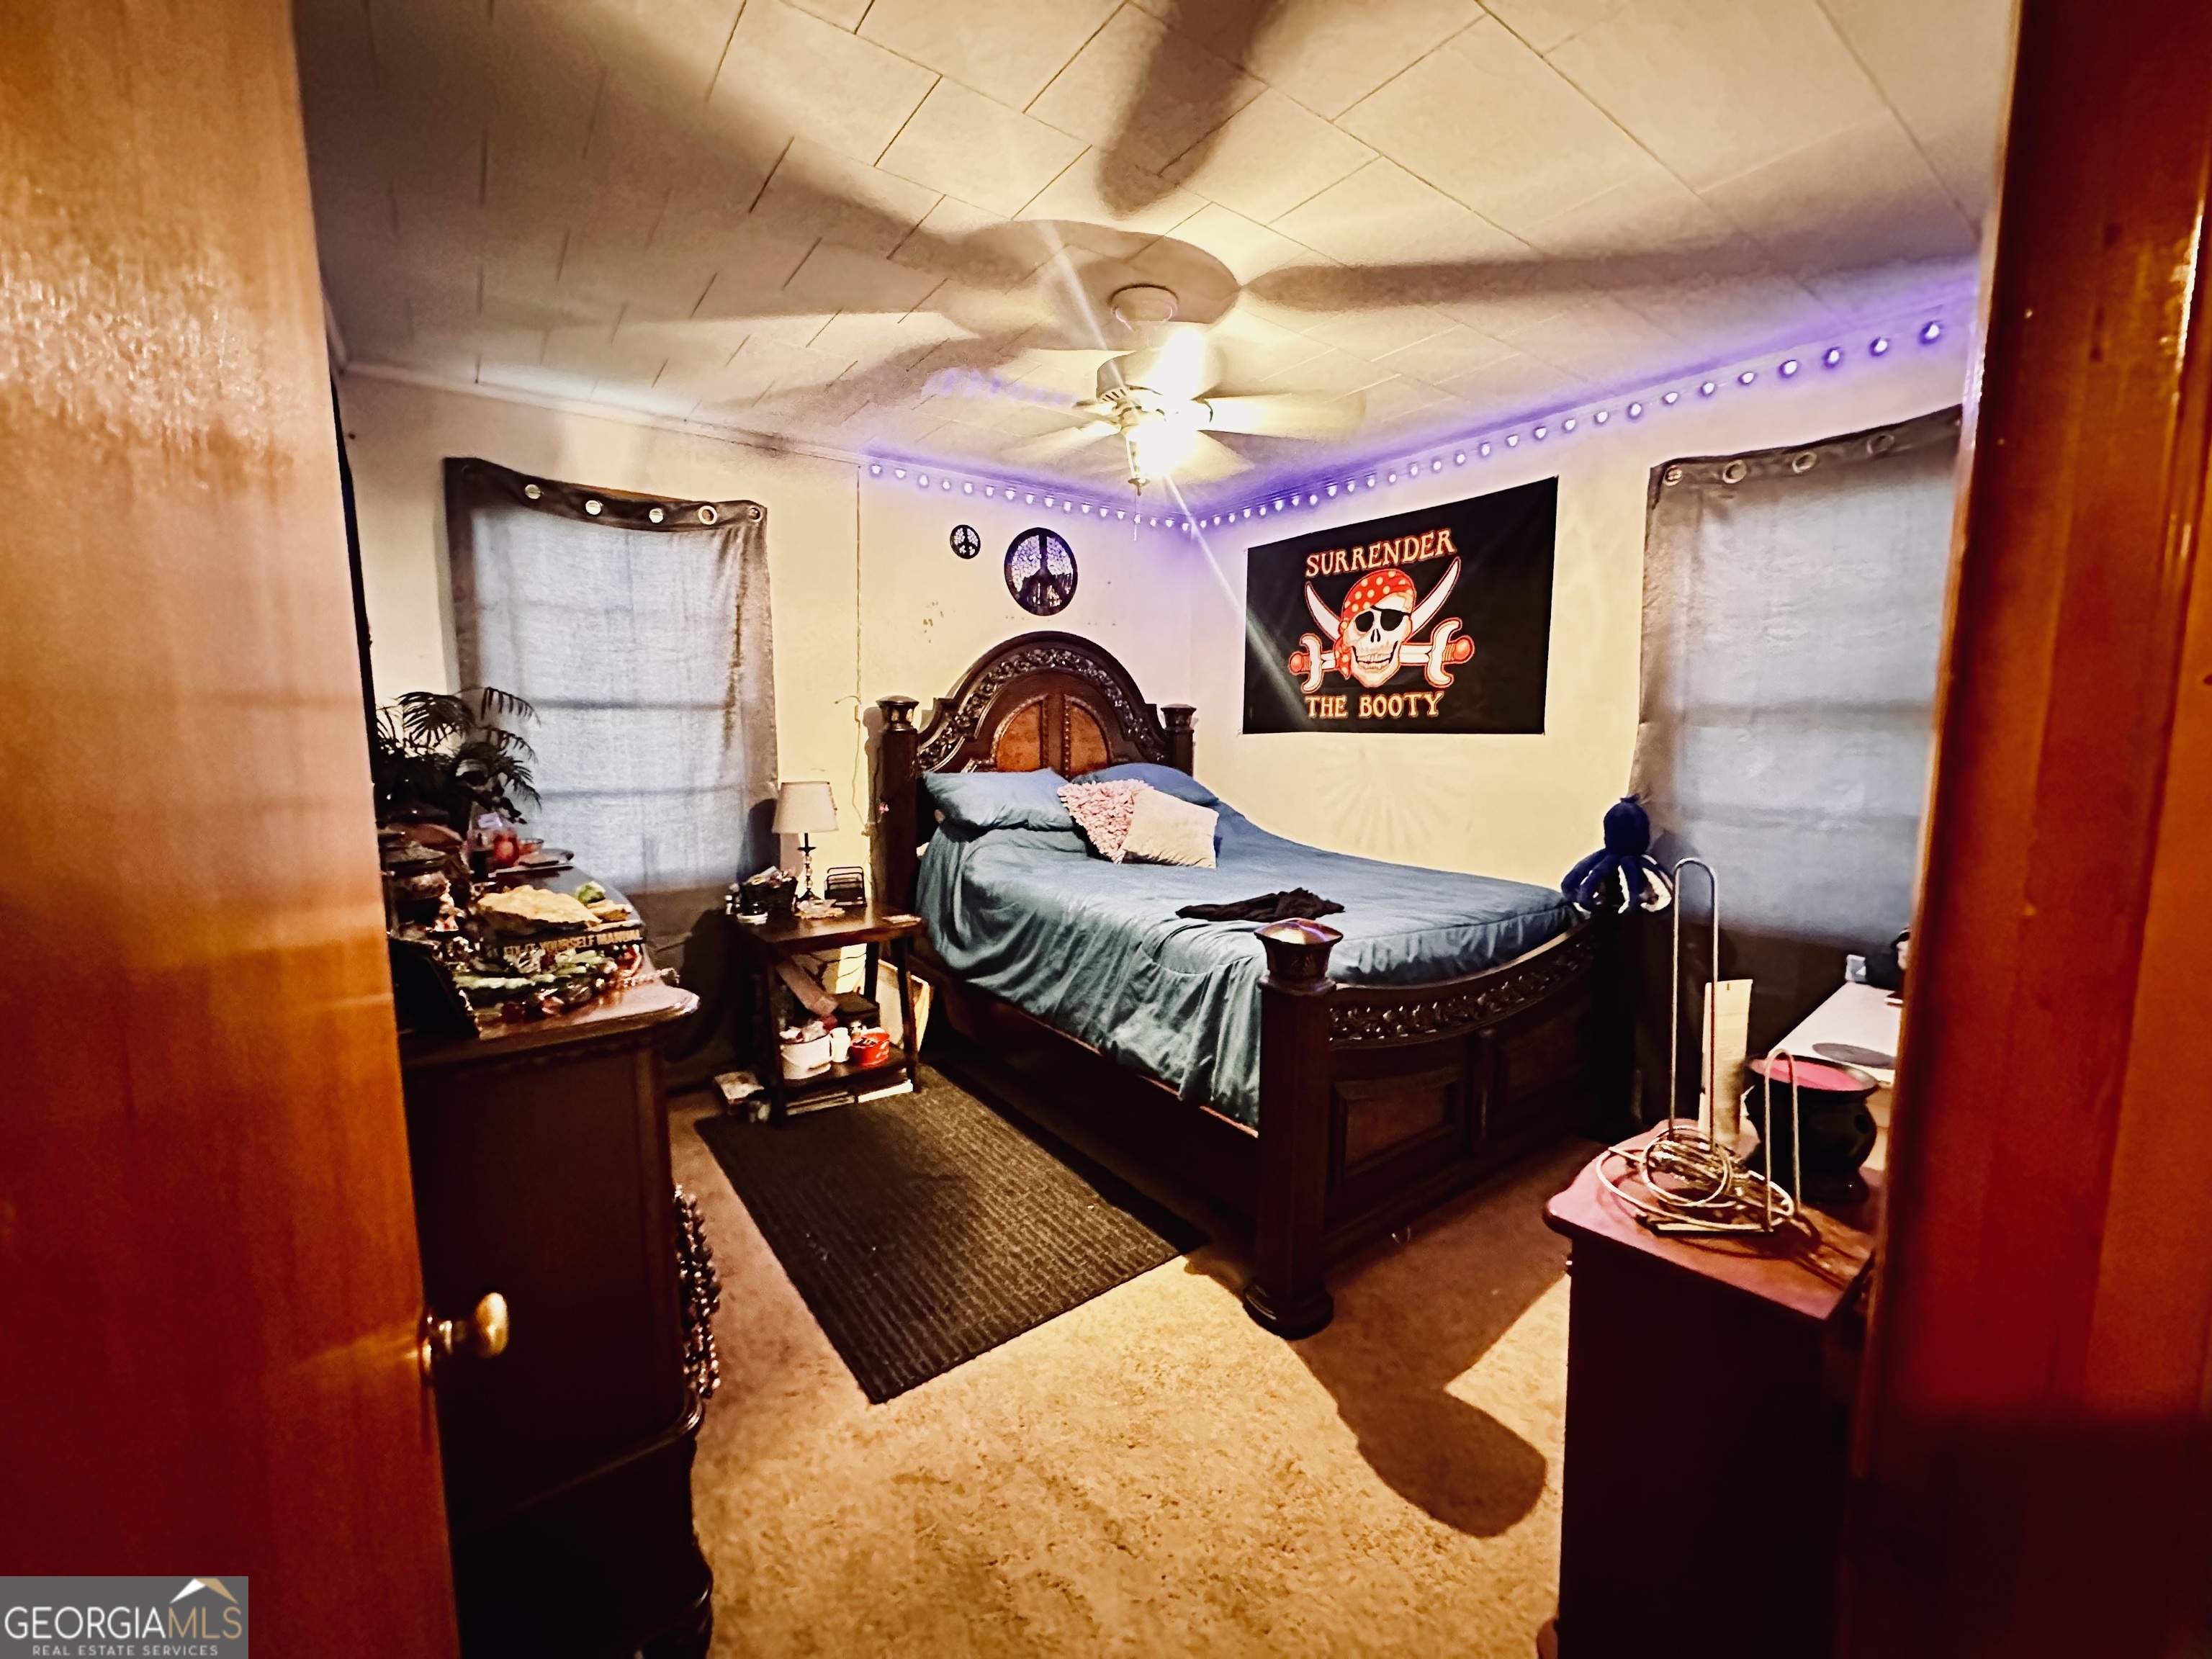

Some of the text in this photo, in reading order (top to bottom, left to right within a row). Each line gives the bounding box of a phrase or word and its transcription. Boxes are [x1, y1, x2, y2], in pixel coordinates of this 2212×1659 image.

[1305, 529, 1457, 577] SURRENDER
[1305, 691, 1444, 719] THE BOOTY
